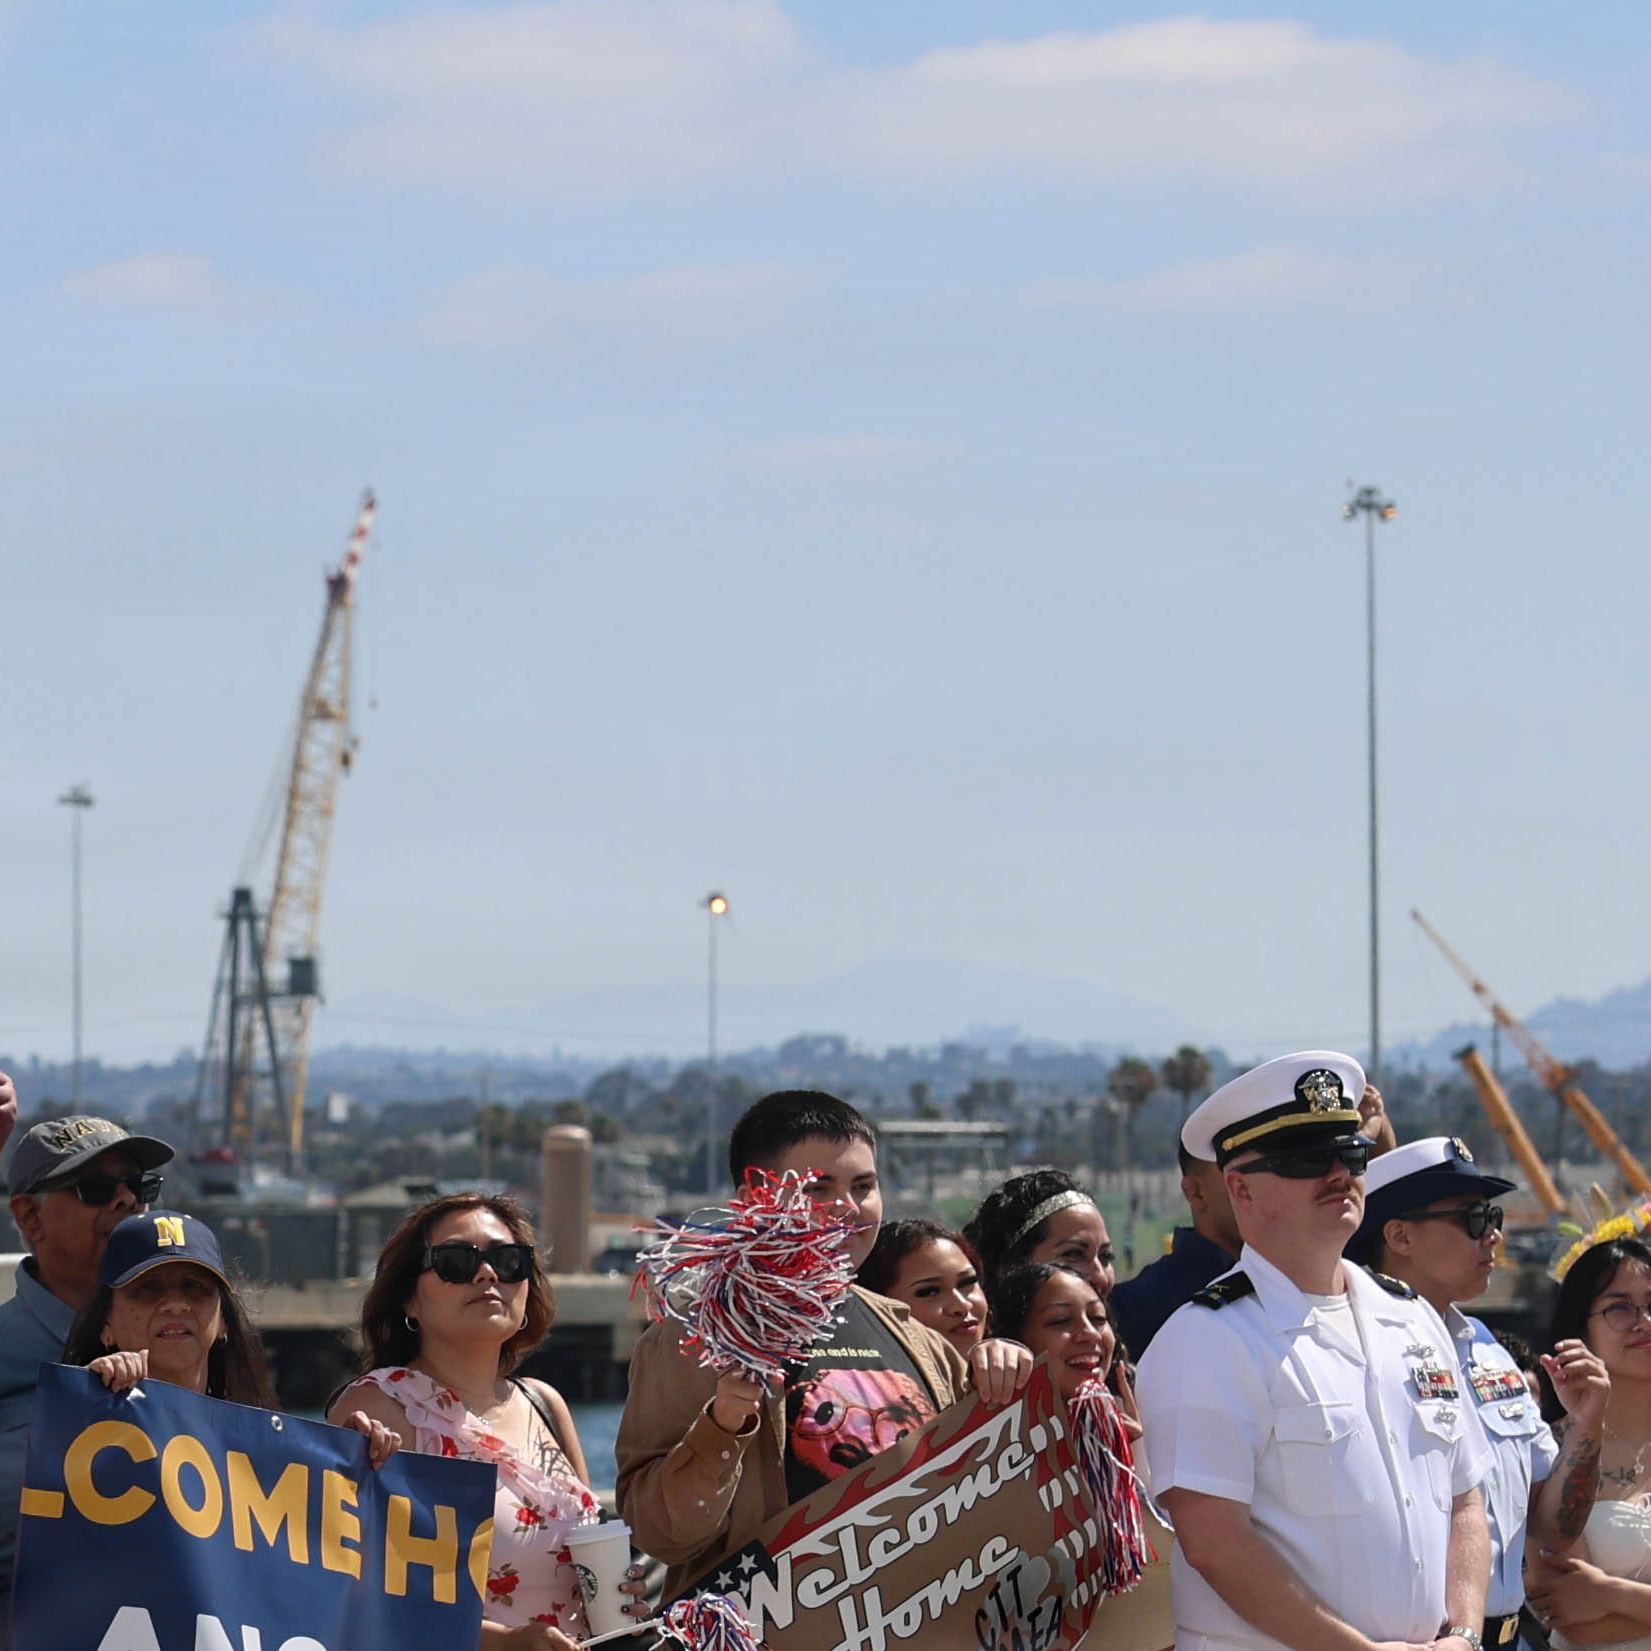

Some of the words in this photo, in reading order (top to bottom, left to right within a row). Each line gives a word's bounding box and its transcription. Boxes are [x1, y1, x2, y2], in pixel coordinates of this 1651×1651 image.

[153, 1216, 186, 1247] N
[20, 1419, 362, 1581] COME
[731, 1440, 1037, 1646] Welcome
